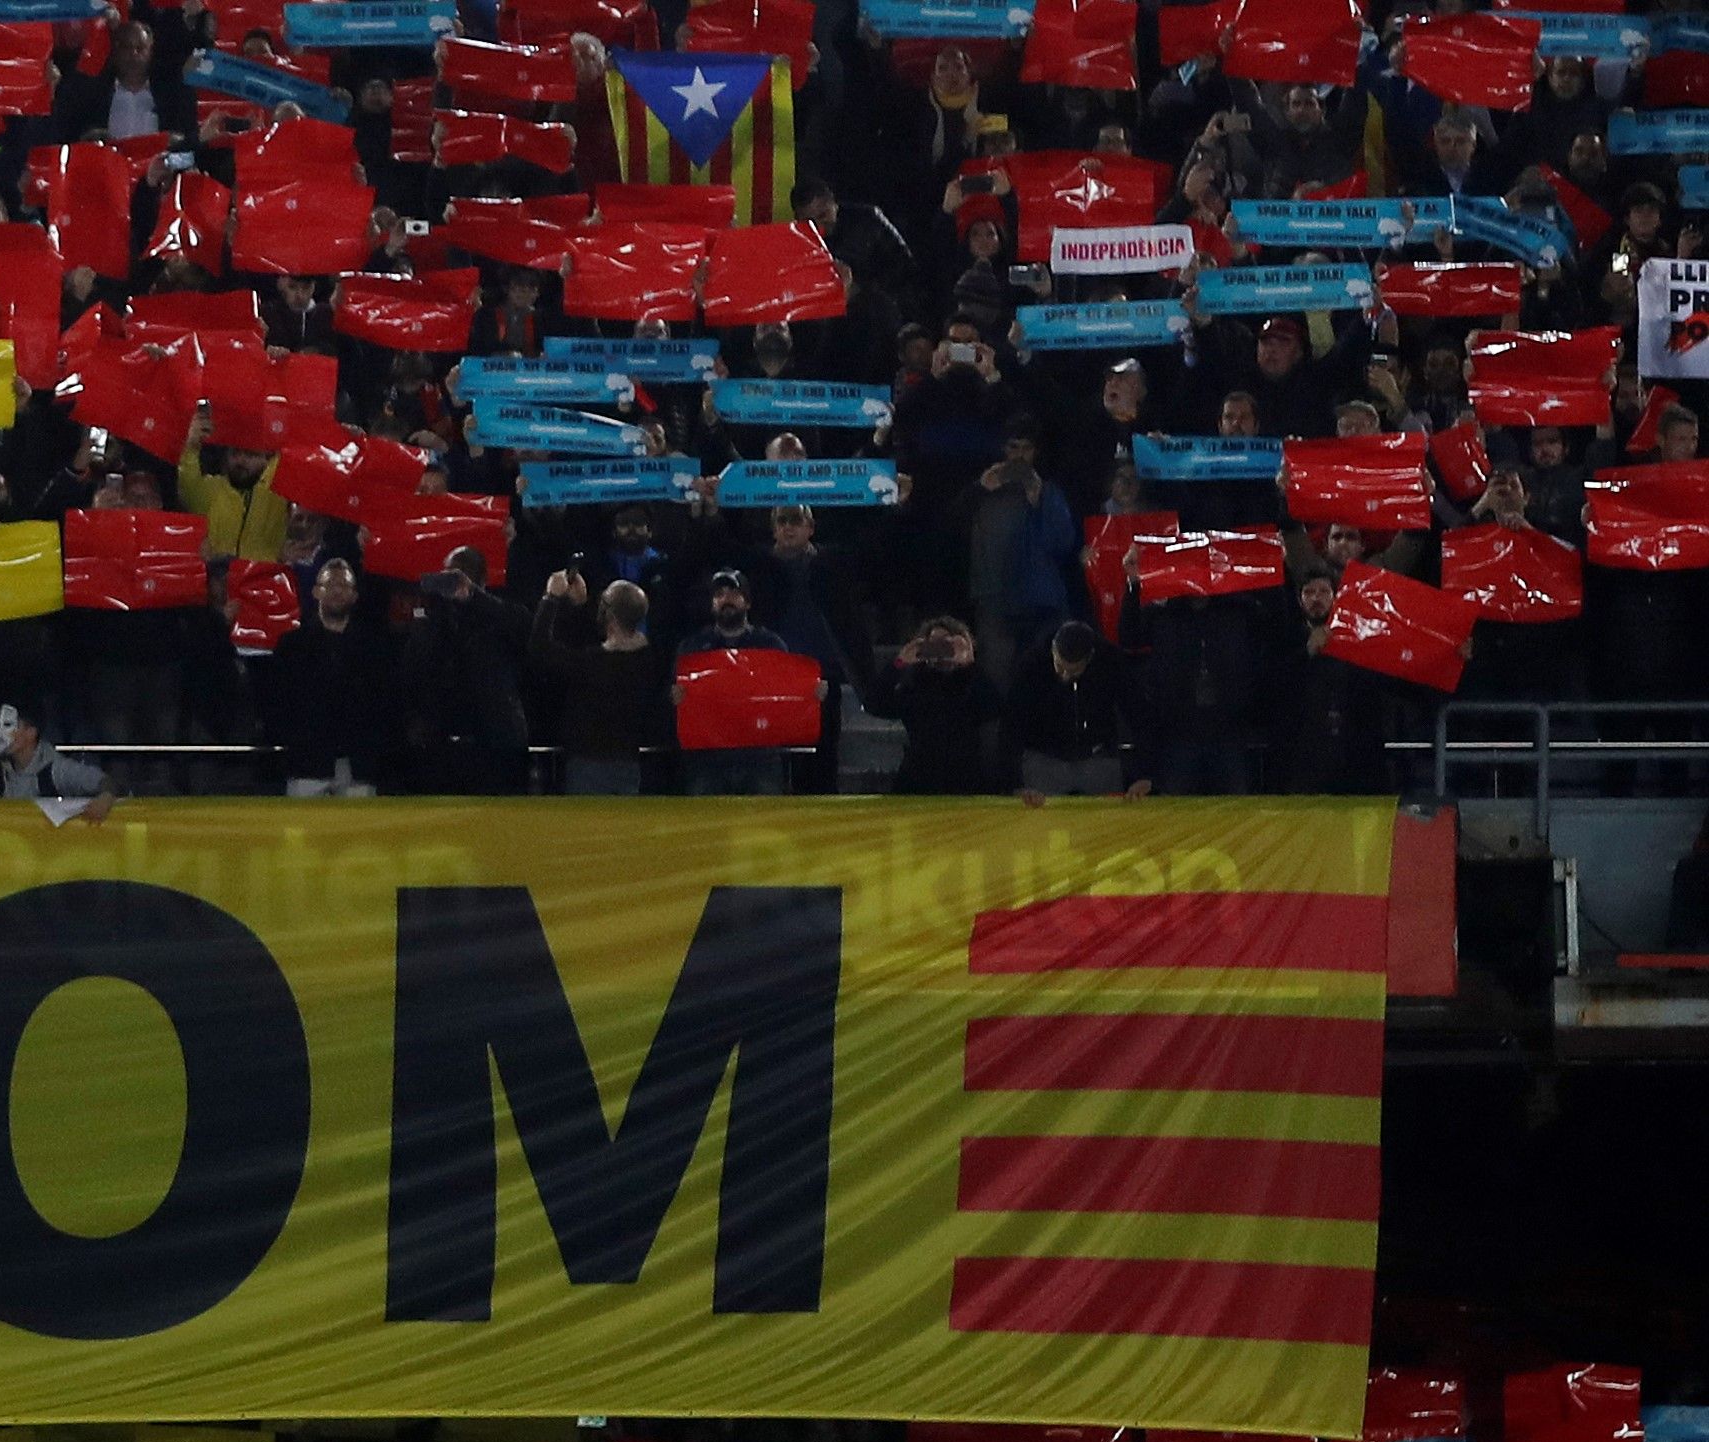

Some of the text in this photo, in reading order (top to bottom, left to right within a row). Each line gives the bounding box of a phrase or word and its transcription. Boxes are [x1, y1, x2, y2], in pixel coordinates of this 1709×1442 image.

[1265, 271, 1282, 282] SIT
[1287, 270, 1309, 281] AND
[788, 466, 804, 477] SIT
[810, 466, 832, 477] AND
